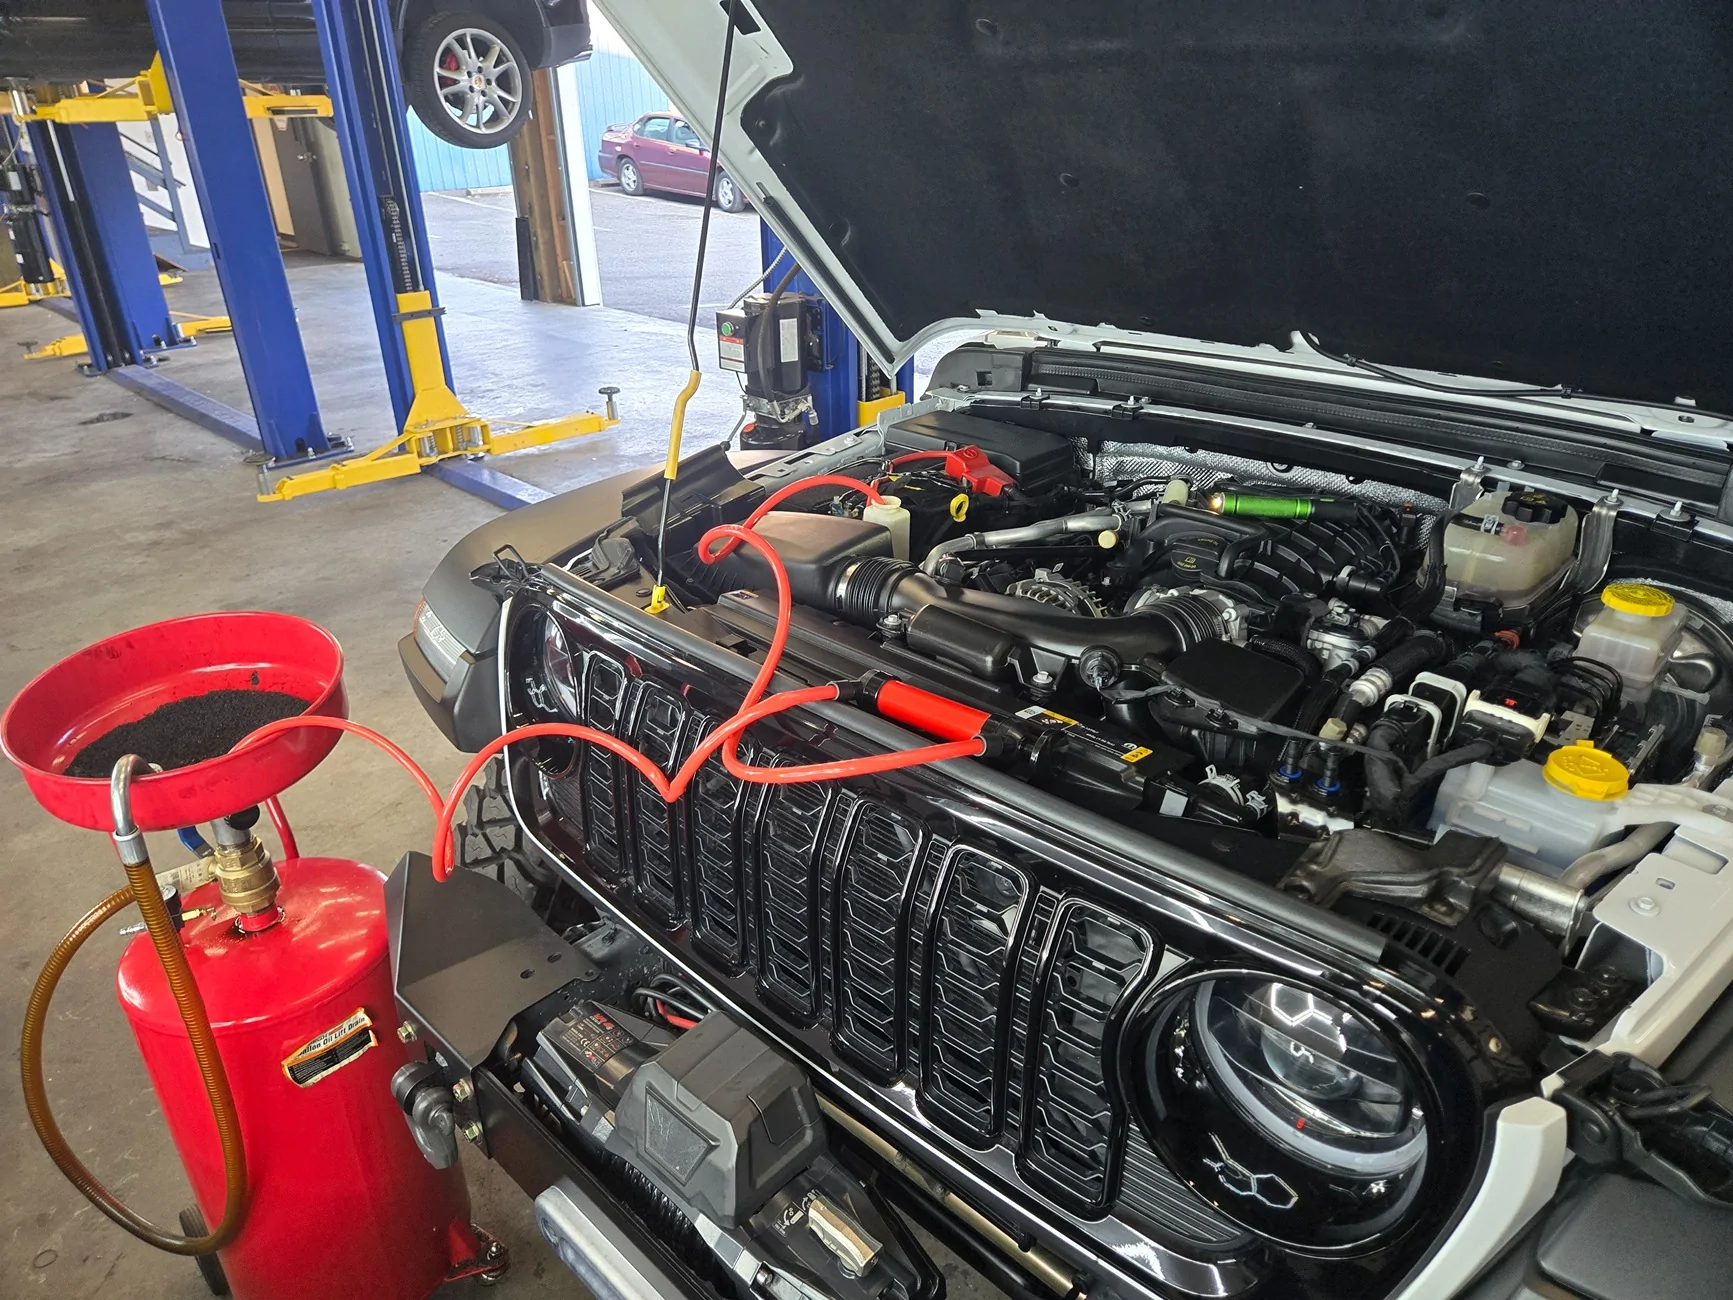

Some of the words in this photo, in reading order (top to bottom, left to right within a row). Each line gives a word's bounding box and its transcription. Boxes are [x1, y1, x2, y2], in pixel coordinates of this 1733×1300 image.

[323, 1036, 333, 1045] Oil
[334, 1027, 346, 1039] Lift
[348, 1017, 365, 1030] Drain
